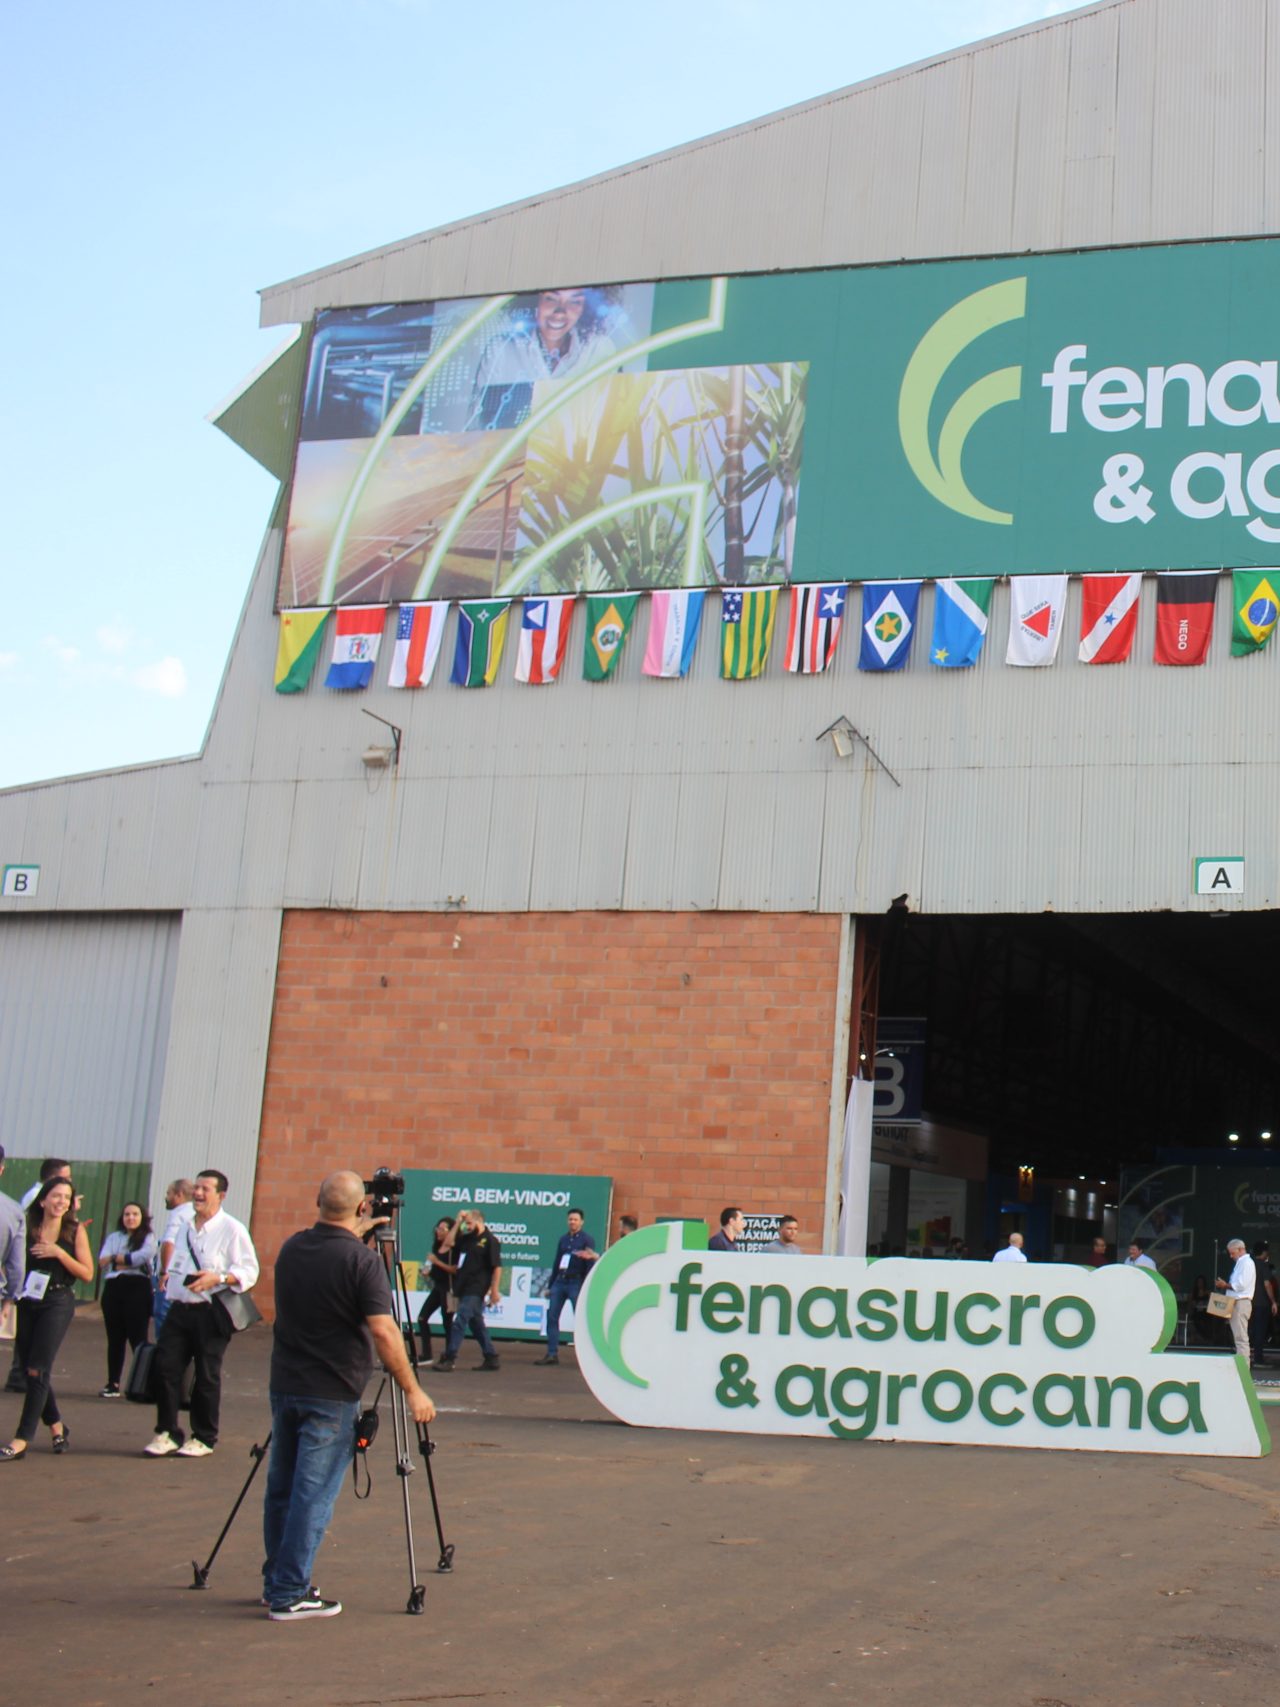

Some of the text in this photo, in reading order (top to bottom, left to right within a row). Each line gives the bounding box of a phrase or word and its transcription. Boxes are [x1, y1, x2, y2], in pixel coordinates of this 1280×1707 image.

[1093, 452, 1157, 524] &
[1178, 619, 1189, 650] NEGO
[14, 873, 28, 892] B
[1210, 867, 1232, 889] A
[432, 1186, 571, 1207] SEJA BEM-VINDO!
[736, 1229, 780, 1241] MÁXIMA
[669, 1262, 1096, 1350] fenasucro
[714, 1353, 1209, 1441] & agrocana
